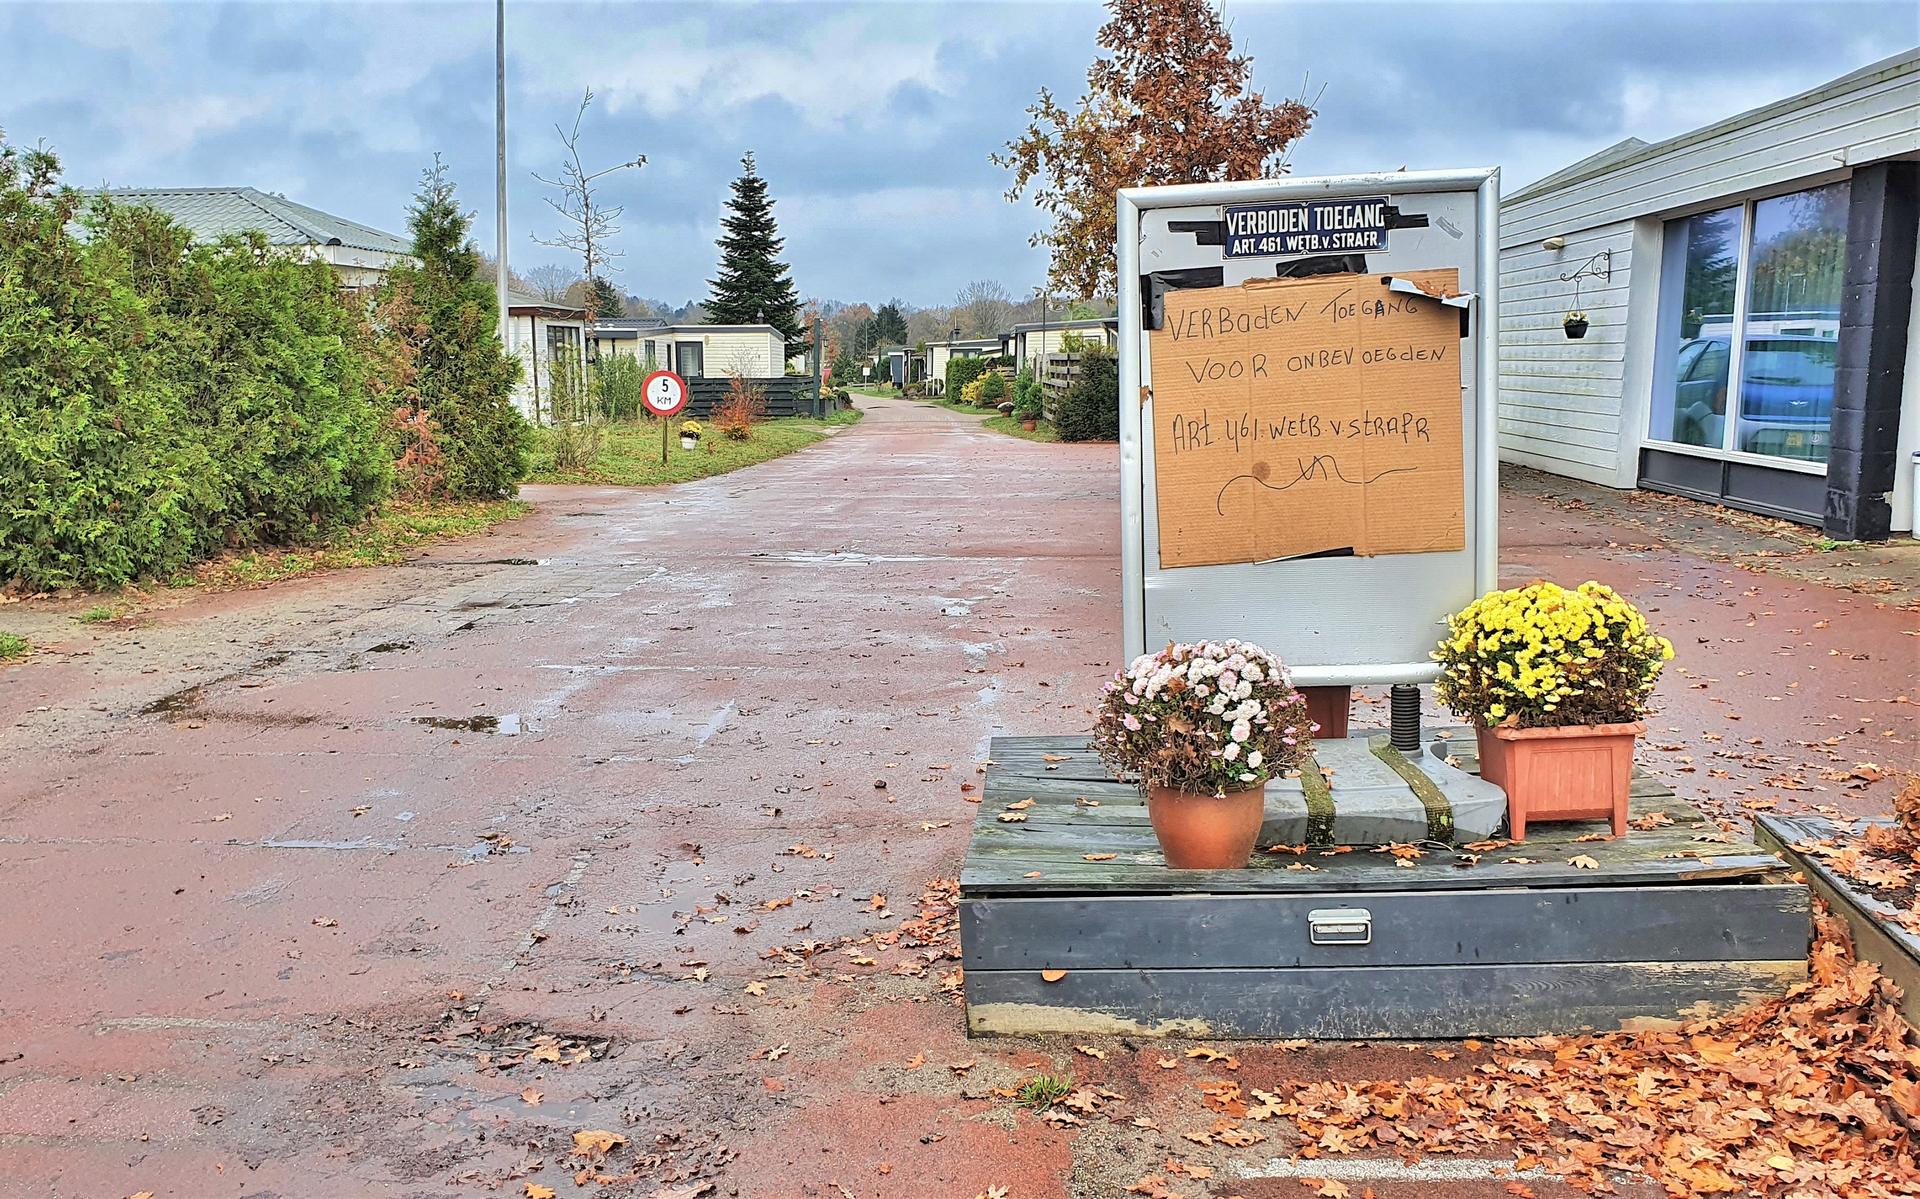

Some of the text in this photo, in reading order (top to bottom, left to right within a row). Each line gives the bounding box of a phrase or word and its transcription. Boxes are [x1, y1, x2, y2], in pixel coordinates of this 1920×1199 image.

[1226, 203, 1385, 236] VERBODEN TOEGANG
[1232, 238, 1258, 255] ART.
[1258, 237, 1285, 253] 461.
[1333, 231, 1382, 248] STRAFR.
[1186, 353, 1268, 384] VOOR
[661, 378, 669, 392] 5
[656, 396, 672, 405] KM
